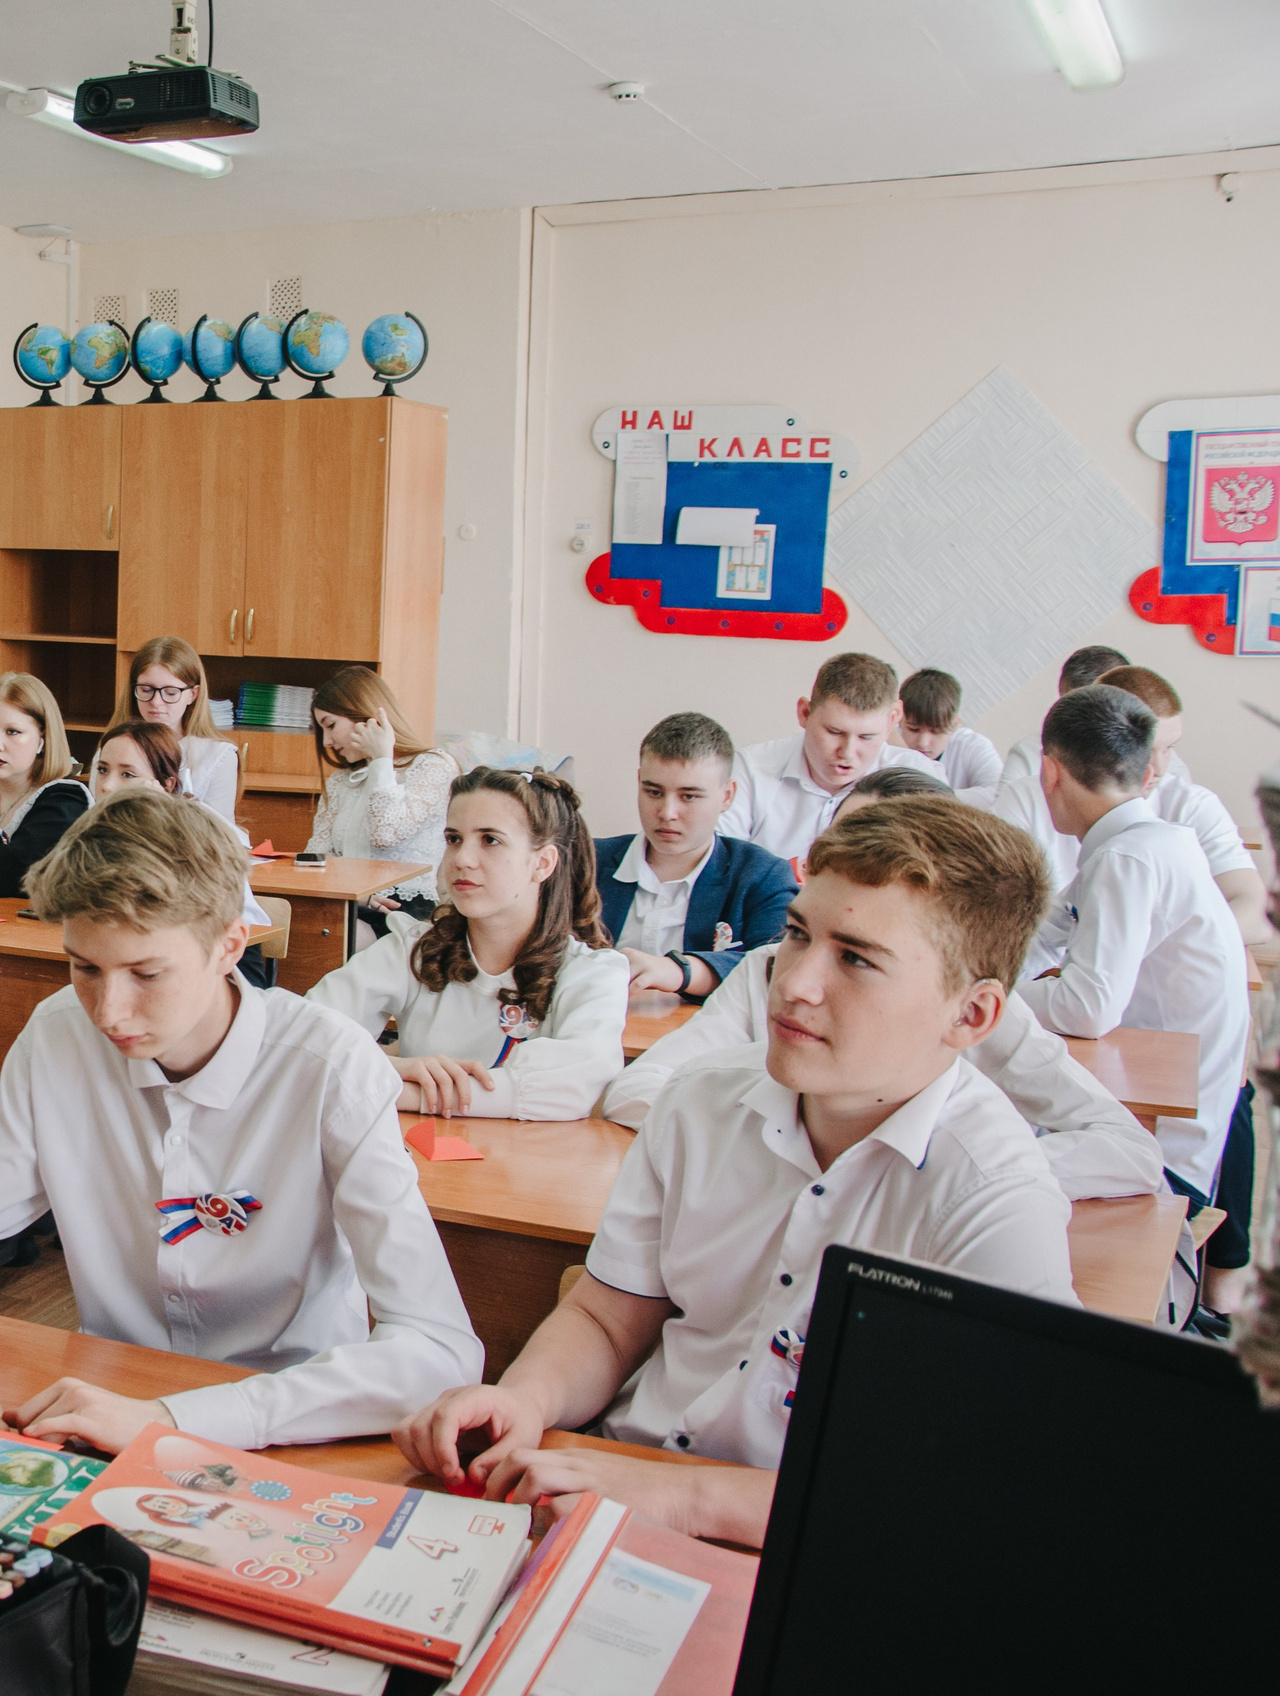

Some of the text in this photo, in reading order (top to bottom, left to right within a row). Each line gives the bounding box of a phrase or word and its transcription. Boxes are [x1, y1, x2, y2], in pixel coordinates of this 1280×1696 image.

[621, 410, 693, 430] НАШ
[699, 437, 831, 458] КЛАСС
[848, 1262, 921, 1293] FLATRON
[232, 1492, 378, 1589] Spotlight
[407, 1535, 458, 1560] 4
